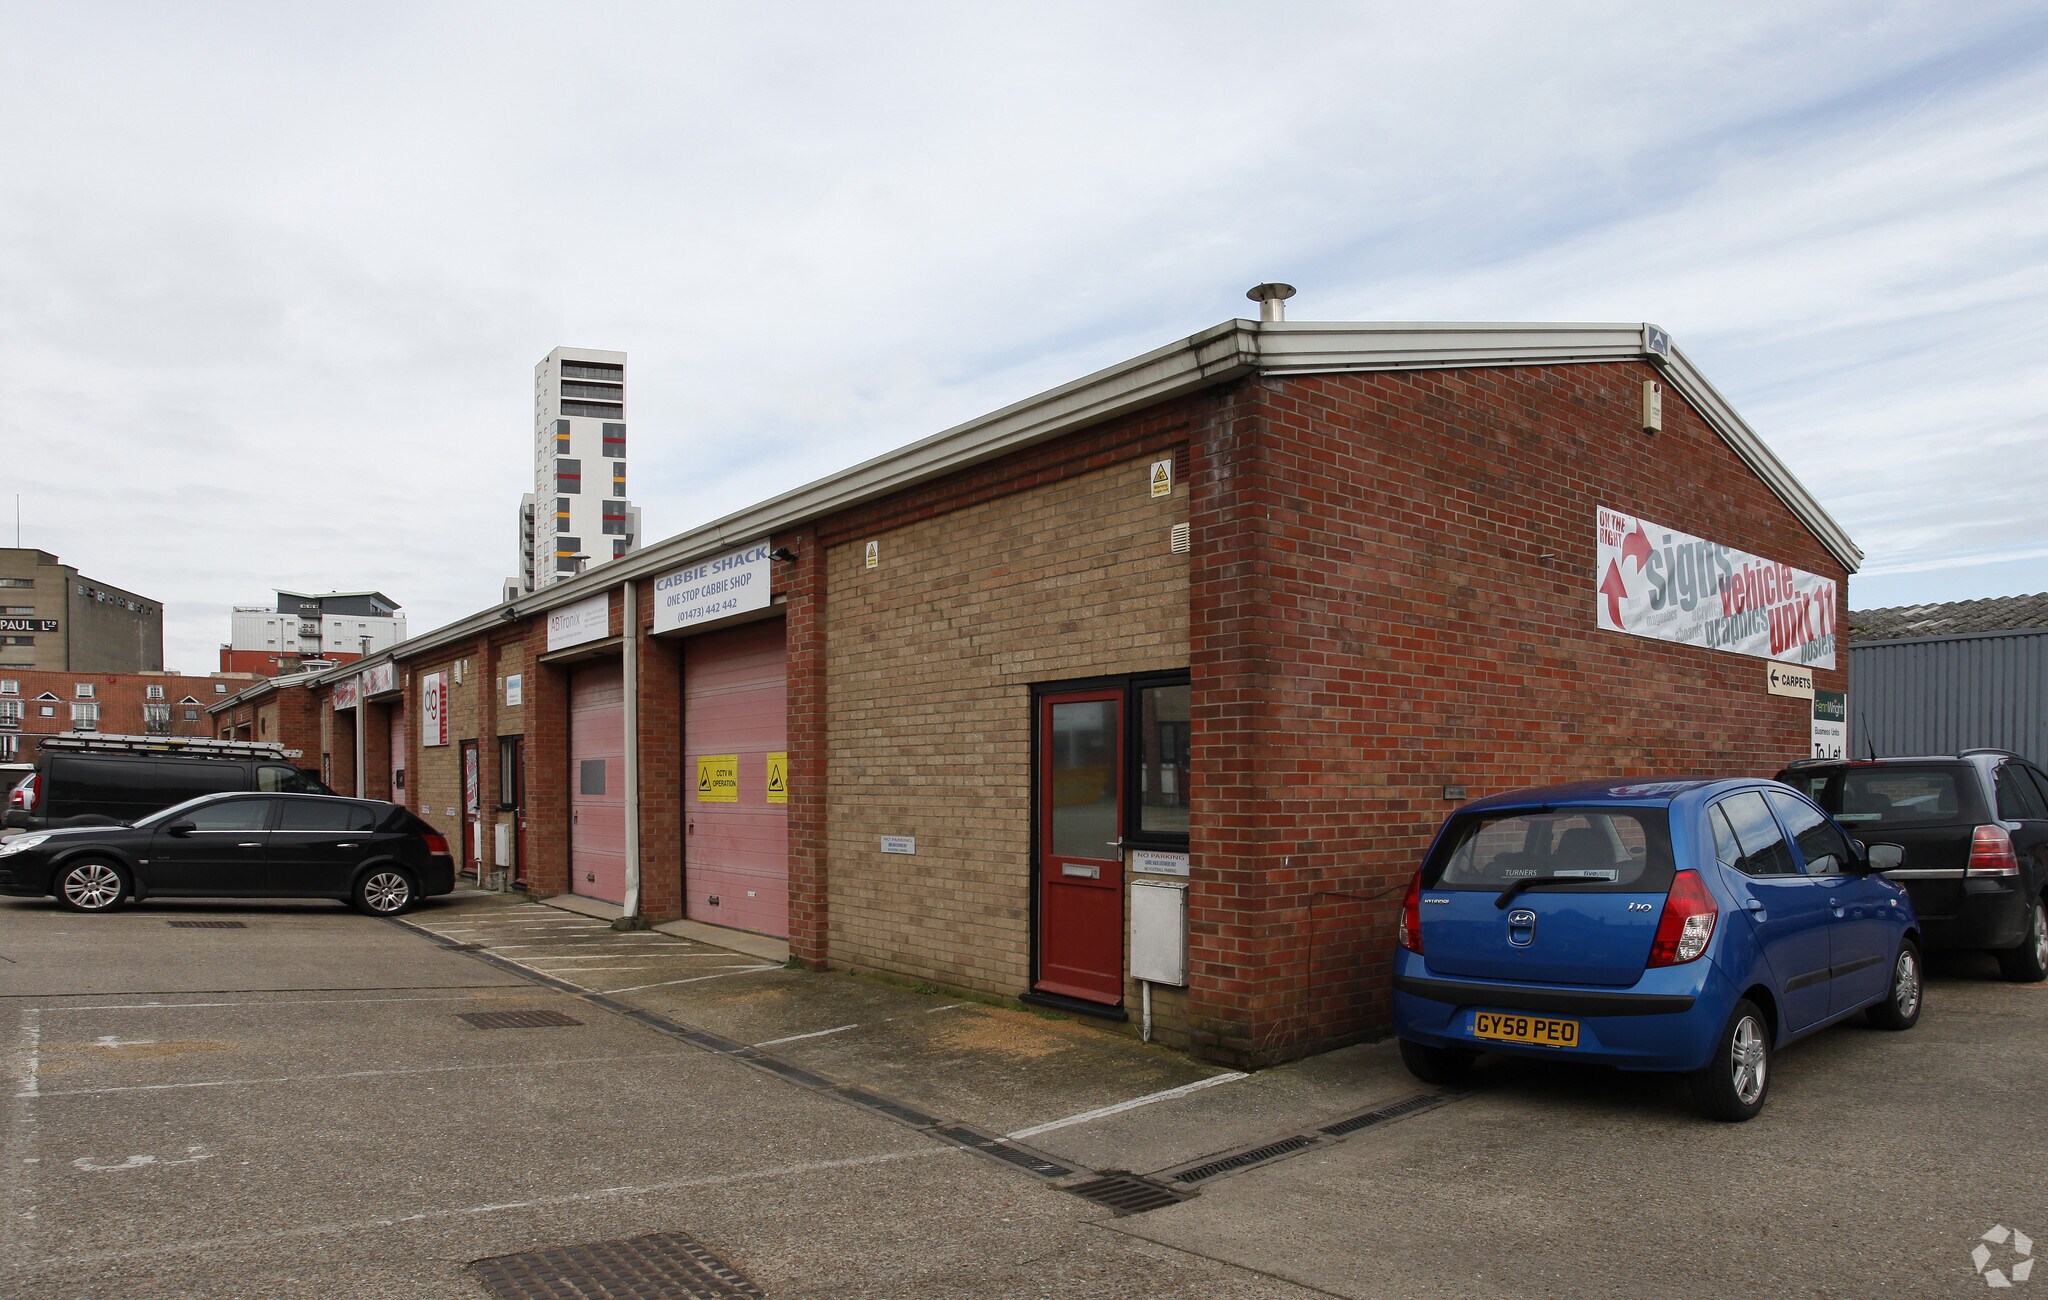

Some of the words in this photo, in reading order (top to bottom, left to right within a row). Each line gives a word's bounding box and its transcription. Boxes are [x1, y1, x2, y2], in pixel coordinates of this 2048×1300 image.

[1599, 510, 1610, 527] ON
[1611, 512, 1626, 533] THE
[1599, 528, 1623, 549] RIGHT
[656, 564, 708, 592] CABBIE
[711, 545, 769, 575] SHACK
[1645, 533, 1733, 612] signs
[666, 592, 681, 608] ONE
[681, 587, 700, 604] STOP
[701, 578, 729, 598] CABBIE
[730, 571, 753, 591] SHOP
[1717, 560, 1794, 618] vehicle
[677, 606, 705, 624] (01473)
[705, 601, 721, 616] 442
[721, 597, 738, 611] 442
[1767, 590, 1815, 656] unit
[1813, 581, 1836, 638] 11
[0, 620, 34, 631] PAUL
[1704, 606, 1769, 650] graphics
[1800, 633, 1836, 664] posters
[1781, 674, 1811, 689] CARPETS
[1814, 727, 1831, 735] Business
[1831, 728, 1840, 737] Units
[1814, 743, 1825, 759] To
[712, 779, 736, 788] OPERATION
[716, 769, 728, 778] CCTV
[727, 769, 733, 777] IN
[1150, 853, 1185, 861] PARKING
[1505, 869, 1538, 877] TURNERS
[1477, 1014, 1528, 1037] GY58
[1533, 1019, 1575, 1042] PEO
